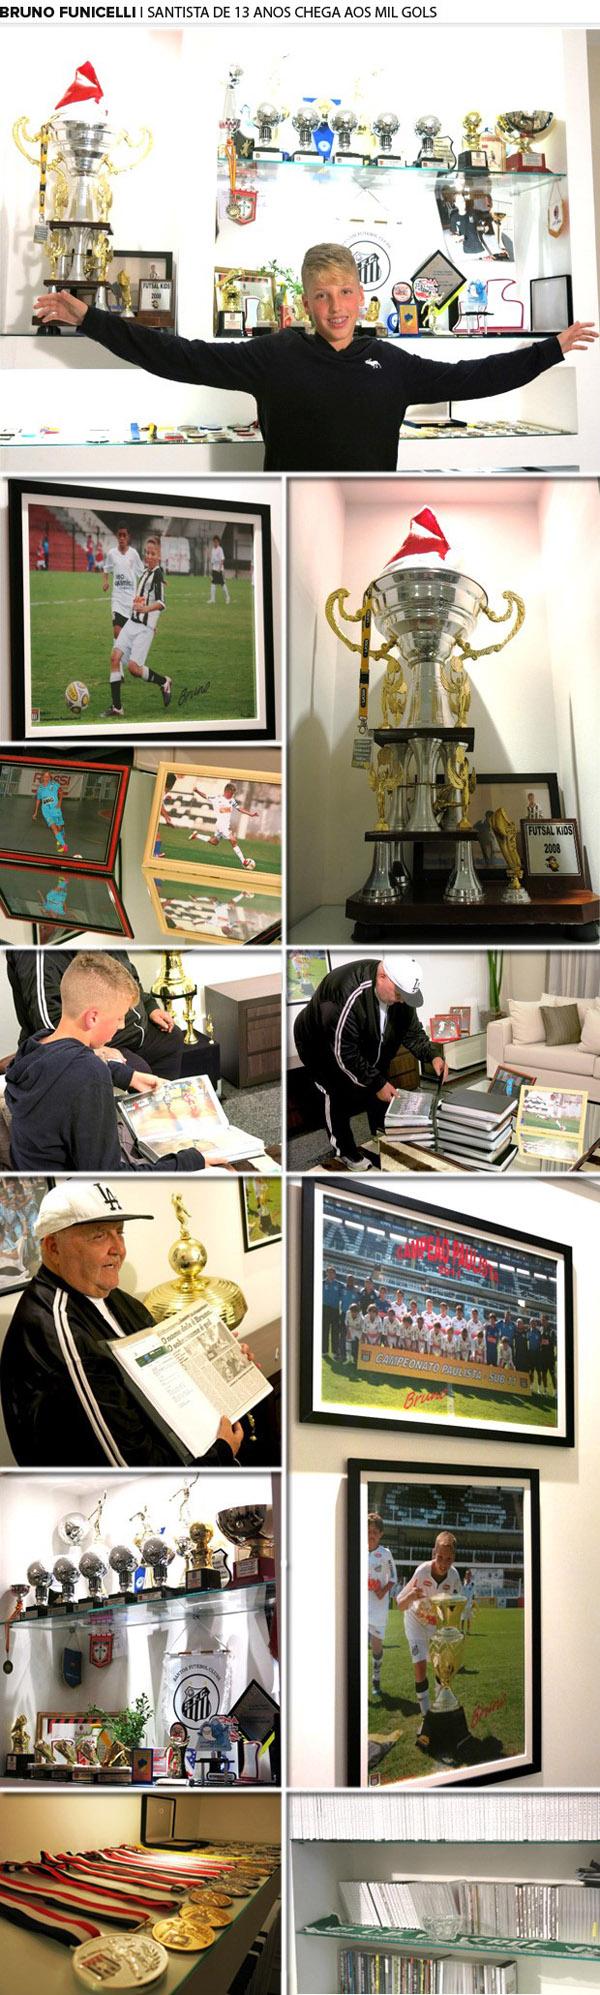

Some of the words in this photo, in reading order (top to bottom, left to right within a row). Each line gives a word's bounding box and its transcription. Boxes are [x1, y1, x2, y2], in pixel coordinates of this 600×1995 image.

[528, 825, 555, 836] FUTSAL
[544, 843, 561, 854] 2008
[93, 1182, 122, 1211] LA
[375, 1353, 440, 1373] CAMPEONATO
[441, 1364, 482, 1380] PAULISTA
[403, 1388, 449, 1410] Bruno
